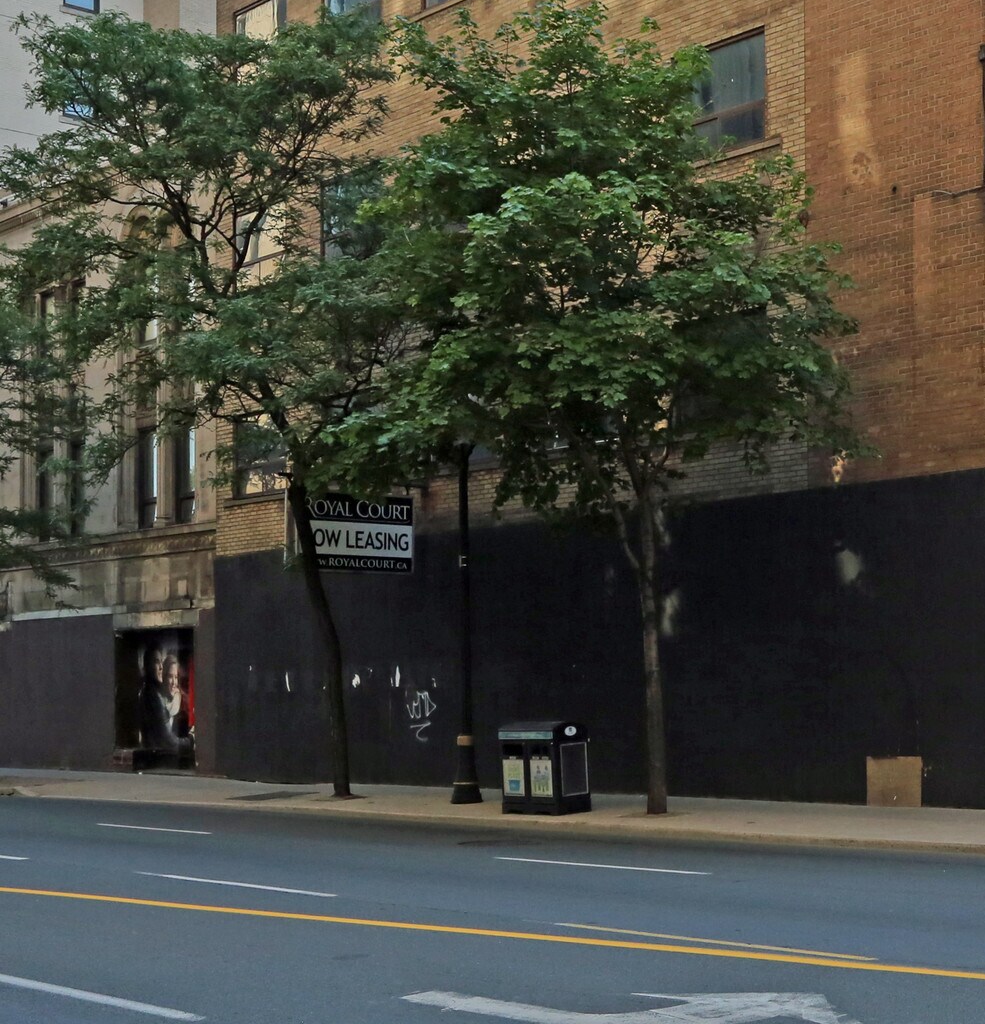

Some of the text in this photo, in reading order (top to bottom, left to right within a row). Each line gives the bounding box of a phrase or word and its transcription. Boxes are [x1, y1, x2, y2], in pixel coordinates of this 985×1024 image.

[356, 500, 411, 520] COURT
[313, 528, 409, 551] OW LEASING
